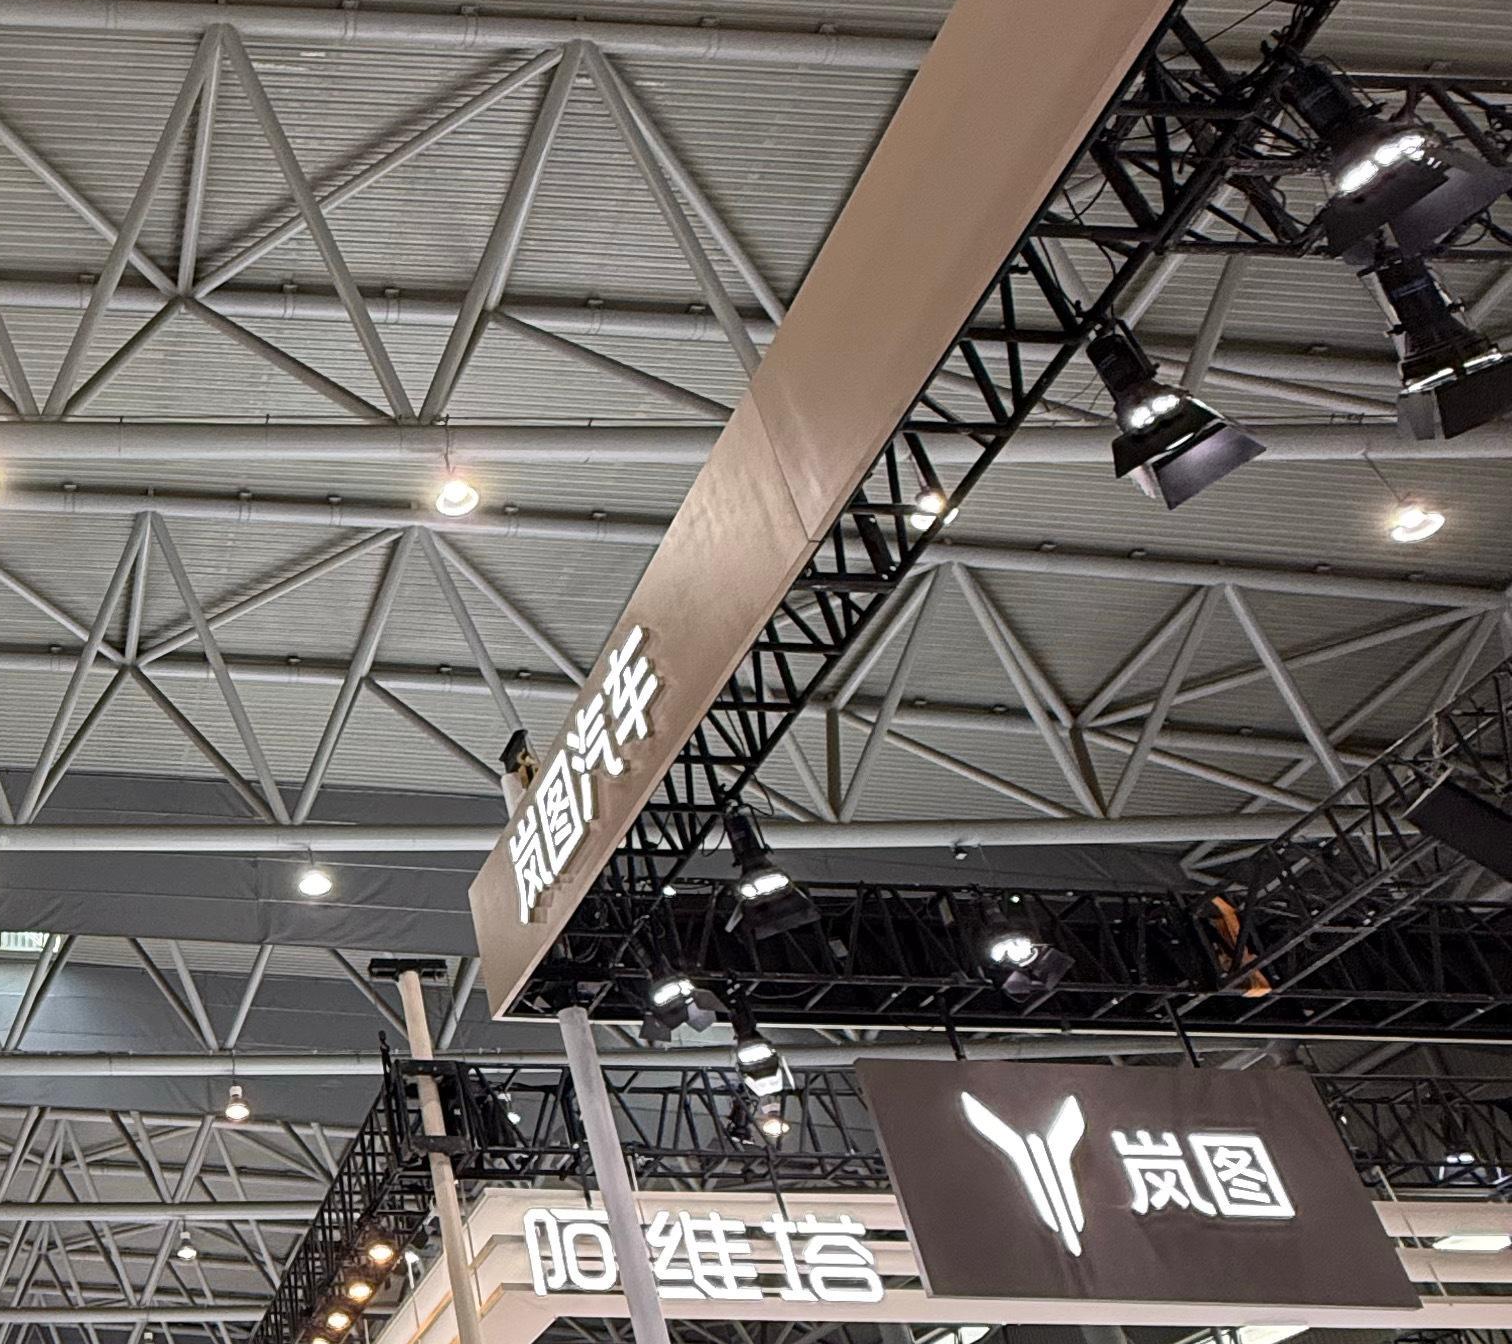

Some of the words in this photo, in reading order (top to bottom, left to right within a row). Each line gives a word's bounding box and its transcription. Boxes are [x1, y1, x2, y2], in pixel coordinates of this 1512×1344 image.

[509, 624, 659, 925] 岚图汽车
[1110, 1130, 1294, 1219] 岚图
[523, 1207, 885, 1303] 阿维塔
